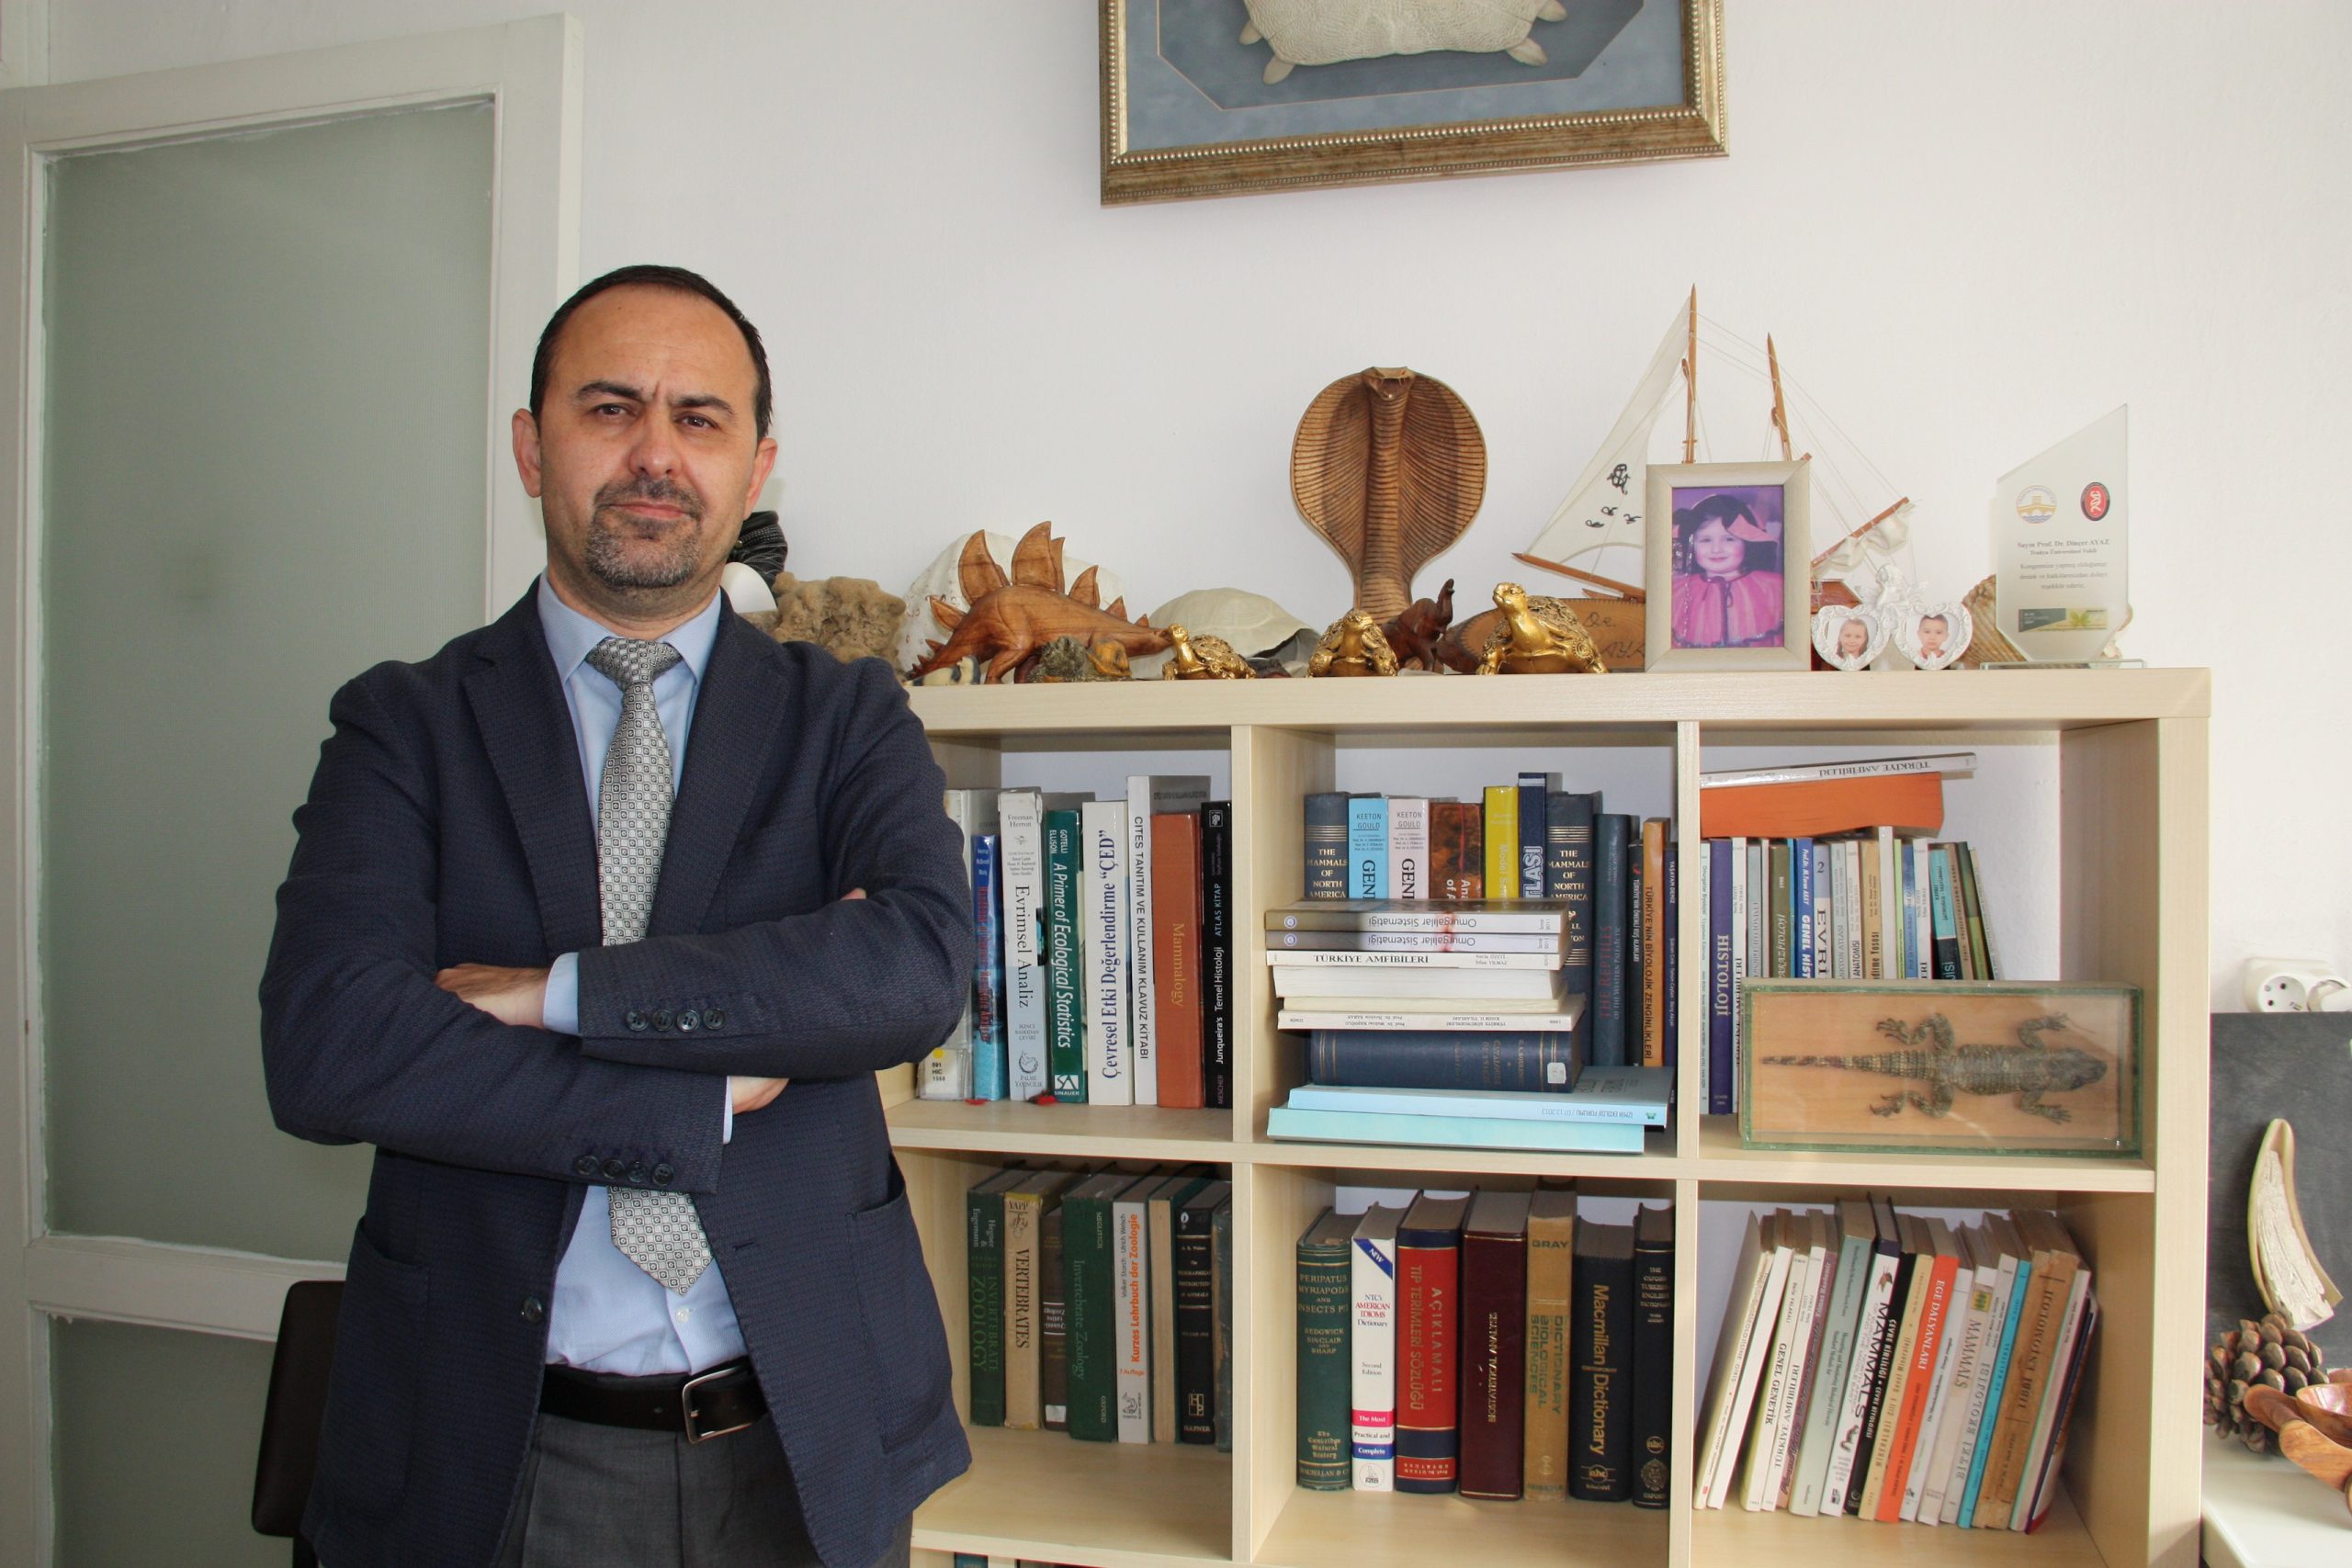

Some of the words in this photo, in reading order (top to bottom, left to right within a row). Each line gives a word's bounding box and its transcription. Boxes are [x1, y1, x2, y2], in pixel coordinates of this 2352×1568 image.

[1818, 764, 1880, 777] AMFİBİLERİ
[1884, 761, 1929, 771] TÜRKİYE
[1049, 829, 1057, 854] ELLISON
[1059, 829, 1069, 853] GOTELLI
[1134, 816, 1144, 850] CITES
[1053, 863, 1068, 871] A
[1306, 859, 1348, 867] MAMMALS
[1317, 848, 1337, 856] THE
[1547, 860, 1591, 868] MAMMALS
[1816, 861, 1826, 874] 2
[1053, 873, 1069, 909] Primer
[1135, 852, 1145, 897] TANITIM
[1313, 880, 1342, 888] NORTH
[1320, 869, 1334, 877] OF
[1446, 878, 1457, 892] of
[1554, 882, 1586, 890] NORTH
[1563, 871, 1577, 879] OF
[1136, 900, 1145, 915] VE
[1212, 883, 1222, 908] KİTAP
[1308, 890, 1346, 899] AMERICA
[1015, 886, 1033, 953] Evrimsel
[1054, 910, 1071, 924] of
[1214, 910, 1222, 936] ATLAS
[1368, 915, 1419, 929] Sistematiği
[1419, 915, 1477, 929] Omurgalılar
[1645, 886, 1655, 942] TÜRKİYE'NİN
[1801, 914, 1812, 950] GENEL
[1099, 883, 1121, 985] Değerlendirme
[1136, 918, 1147, 975] KULLANIM
[1367, 933, 1419, 948] Sistematiği
[1420, 934, 1476, 948] Omurgalılar
[1775, 913, 1788, 978] ARAZİTOLOJİ
[1051, 924, 1074, 989] Ecological
[1171, 922, 1187, 1007] Mammalogy
[1212, 945, 1225, 983] Histoloji
[1313, 953, 1359, 964] TÜRKİYE
[1367, 953, 1430, 964] AMFİBİLERİ
[1645, 943, 1655, 991] BİYOLOJİK
[1849, 940, 1860, 976] ANATOMİSİ
[1018, 959, 1035, 1009] Analiz
[1714, 933, 1731, 1017] HİSTOLOJİ
[1101, 988, 1117, 1017] Etki
[1137, 977, 1148, 1021] KLAVUZ
[1213, 984, 1223, 1011] Temel
[1057, 991, 1076, 1049] Statistics
[1644, 992, 1655, 1060] ZENGİNLİKLERİ
[1102, 1021, 1122, 1079] Çevresel
[1138, 1023, 1150, 1059] KİTABI
[1009, 1201, 1029, 1210] YAPP
[970, 1208, 980, 1247] Engemann
[987, 1219, 997, 1247] Hegner
[1127, 1213, 1139, 1258] Zoologie
[1532, 1239, 1568, 1248] GRAY
[1128, 1260, 1138, 1279] der
[1368, 1247, 1385, 1264] NEW
[1298, 1285, 1349, 1294] MYRIAPODS
[1299, 1273, 1347, 1283] PERIPATUS
[1409, 1265, 1423, 1283] TIP
[1932, 1280, 1945, 1301] EGE
[1015, 1248, 1030, 1349] VERTEBRATES
[1073, 1259, 1089, 1328] Invertebrate
[1129, 1281, 1140, 1326] Lehrbuch
[970, 1276, 988, 1371] ZOOLOGY
[987, 1276, 999, 1373] INVERTEBRATE
[1304, 1327, 1345, 1336] SEDGWICK
[1357, 1319, 1388, 1328] Dictionary
[1360, 1310, 1386, 1318] IDIOMS
[1409, 1286, 1424, 1348] TERİMLERİ
[1592, 1283, 1610, 1365] Macmillan
[1883, 1317, 1897, 1343] ÇEVRE
[2024, 1289, 2054, 1371] ENTOMOLOJİ
[1130, 1329, 1140, 1362] Kurzes
[1428, 1287, 1443, 1393] AÇIKLAMALI
[1488, 1312, 1498, 1354] ANALYSIS
[1917, 1301, 1940, 1371] DALYANLARI
[1071, 1331, 1089, 1380] Zoology
[1529, 1314, 1540, 1394] SCIENCES
[1538, 1314, 1550, 1408] BIOLOGICAL
[1552, 1314, 1564, 1415] DICTIONARY
[1773, 1342, 1787, 1377] GENEL
[1857, 1302, 1890, 1418] MAMMALS
[1877, 1344, 1893, 1379] KİRLİLİĞİ
[1953, 1318, 1983, 1389] MAMMALS
[1408, 1350, 1425, 1410] SÖZLÜĞÜ
[1487, 1356, 1498, 1423] BIOSTATISTICAL
[1781, 1363, 1801, 1422] AMFİBİLERİ
[1589, 1373, 1610, 1456] Dictionary
[1764, 1379, 1781, 1426] GENETİK
[1954, 1440, 1973, 1480] BİTKİ
[1964, 1360, 1991, 1435] EKOLOJİSİ
[1773, 1423, 1790, 1469] TÜRKİYE
